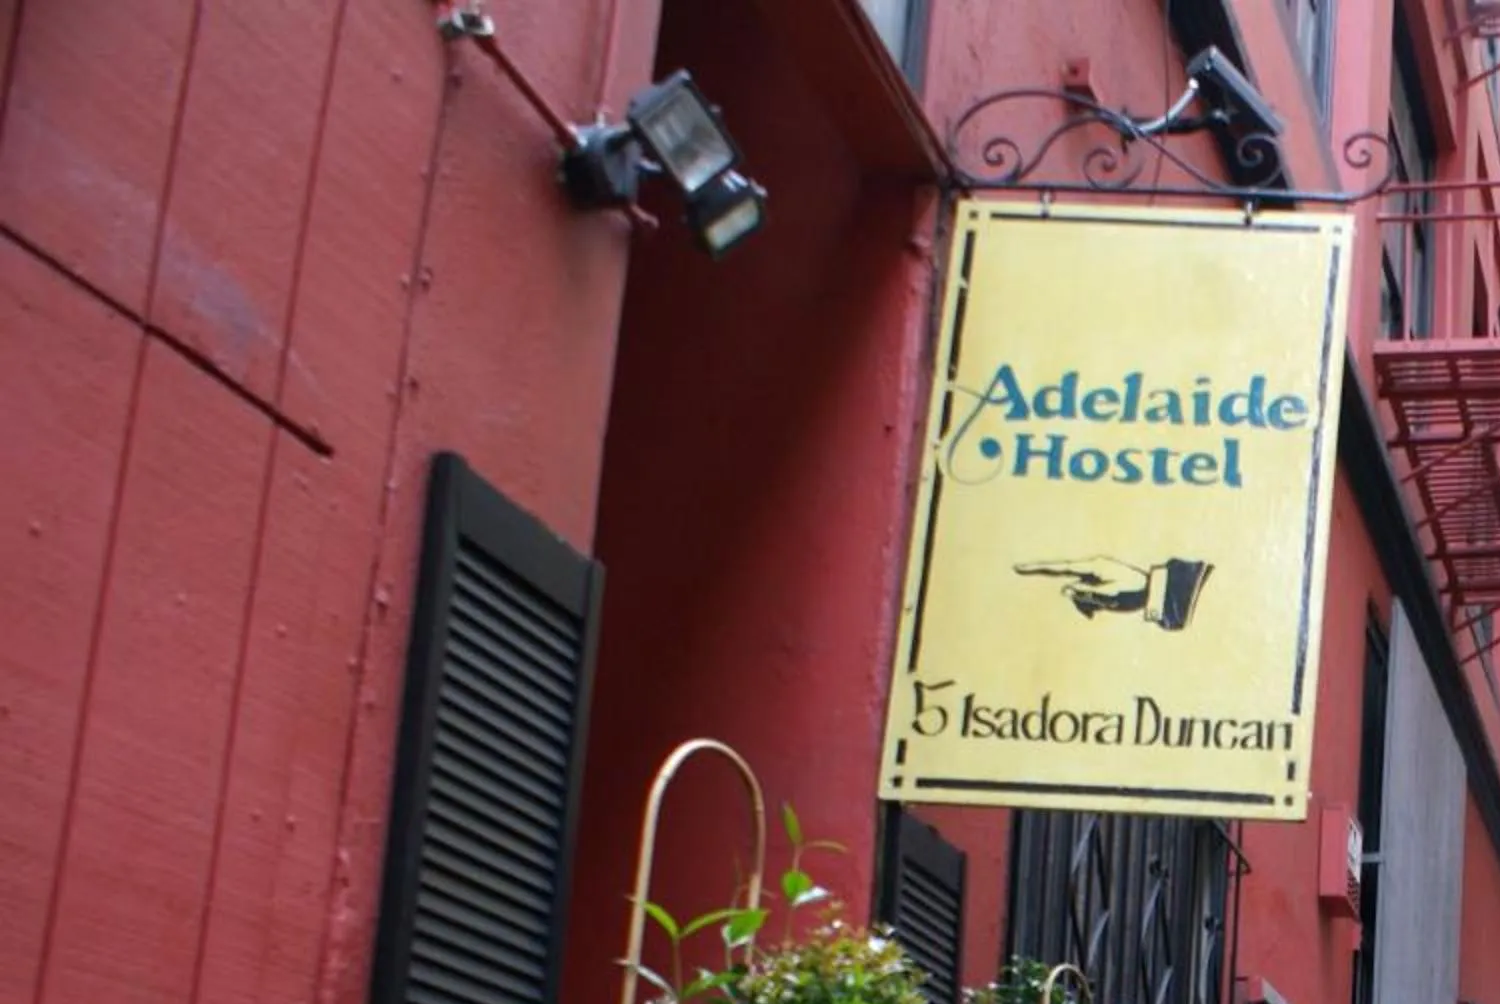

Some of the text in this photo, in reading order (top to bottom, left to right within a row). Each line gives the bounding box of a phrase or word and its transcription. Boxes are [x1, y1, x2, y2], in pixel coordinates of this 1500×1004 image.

[1011, 433, 1243, 488] Hostel
[911, 679, 1293, 750] 5 Isadora Duncan
